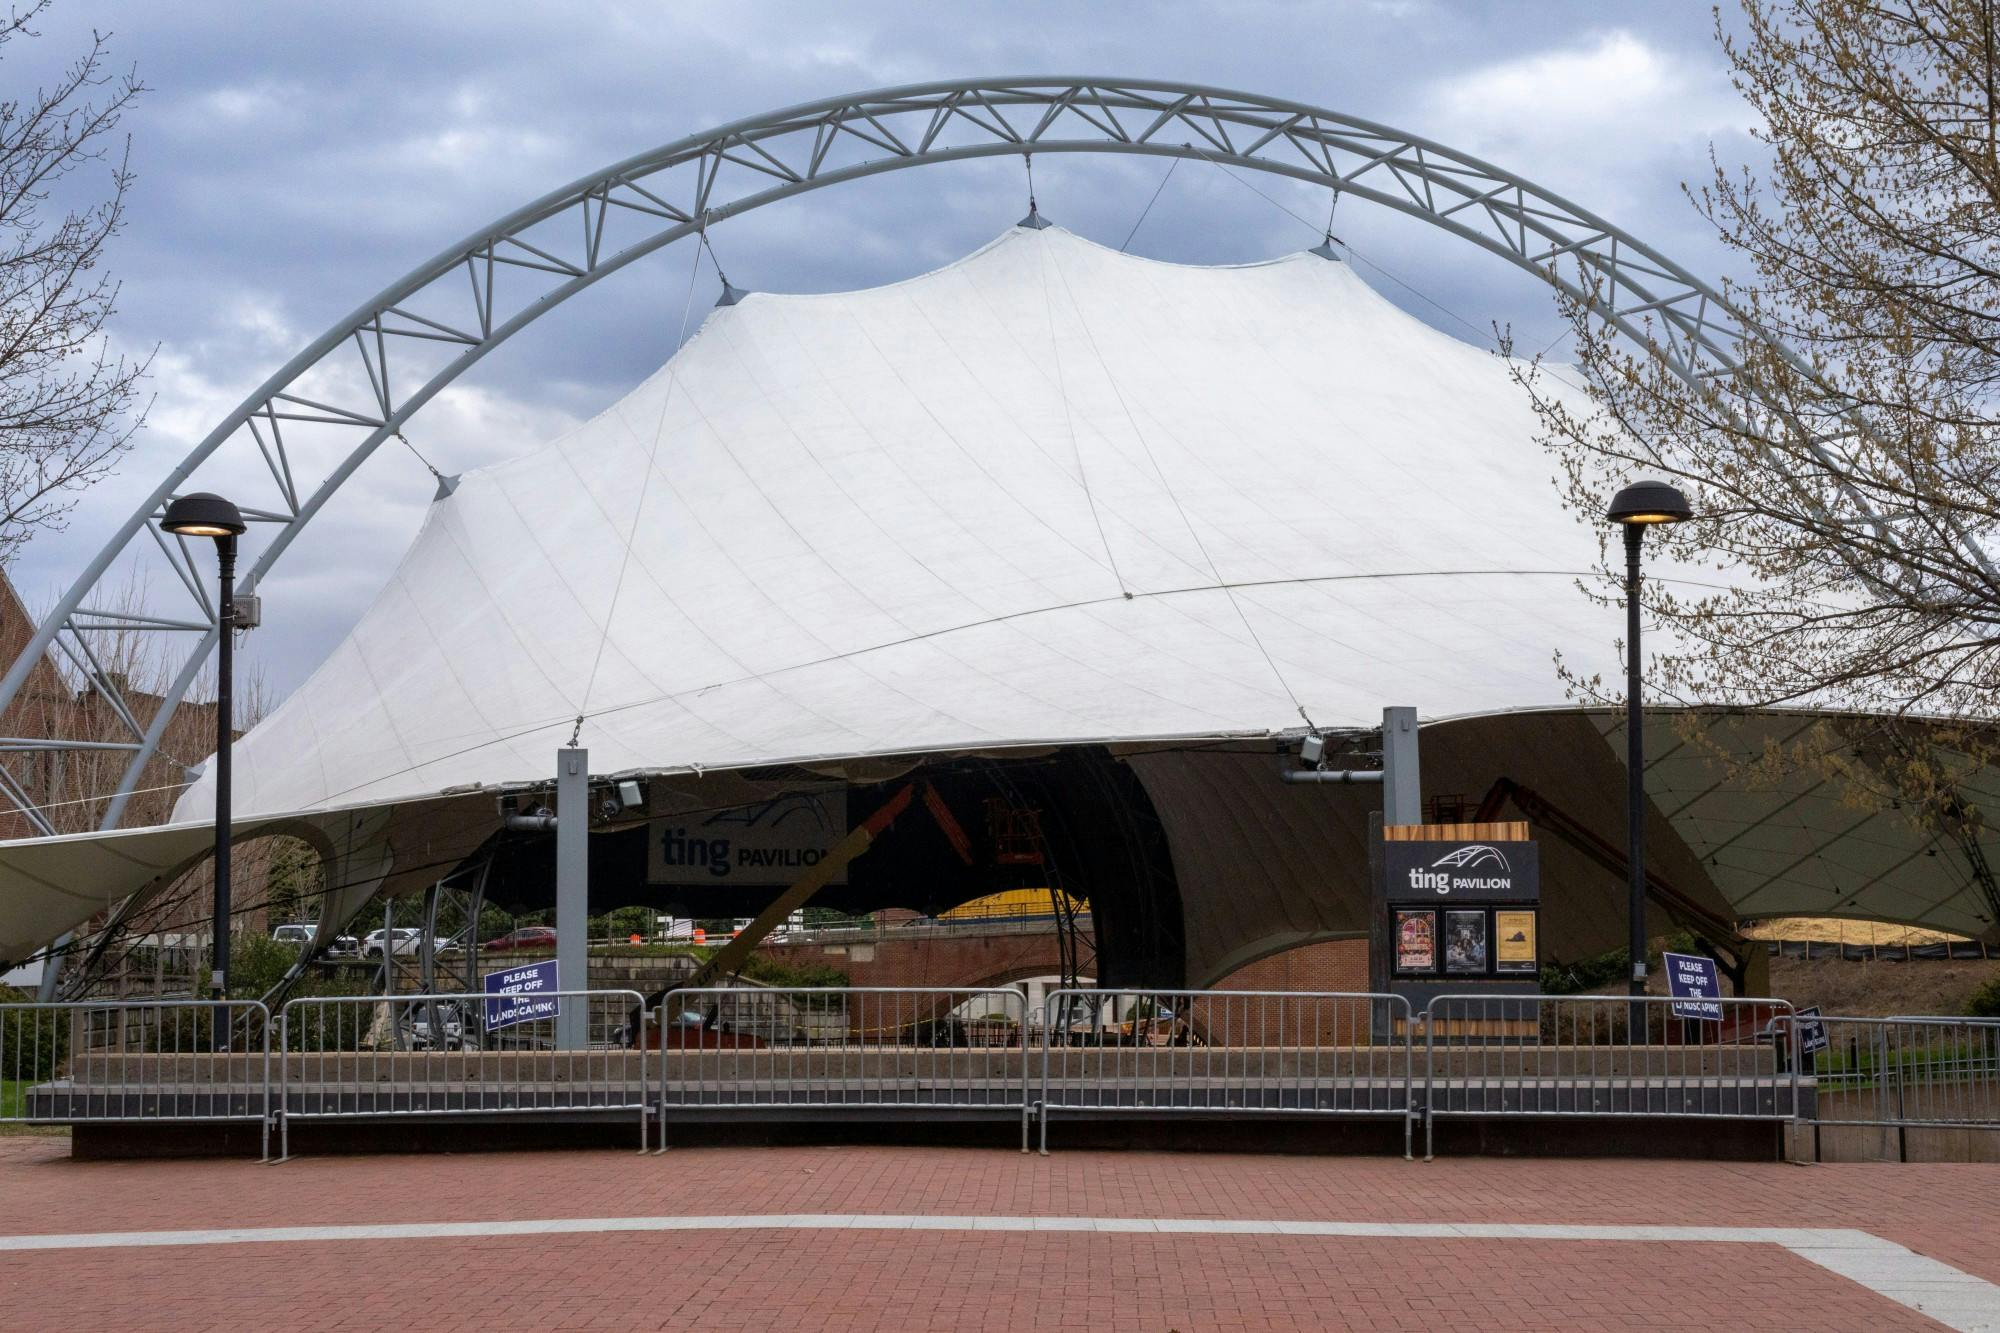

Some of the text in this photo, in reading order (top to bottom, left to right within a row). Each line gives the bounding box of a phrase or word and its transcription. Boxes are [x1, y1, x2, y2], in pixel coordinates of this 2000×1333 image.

[661, 828, 828, 877] ting PAVILIO
[1408, 867, 1511, 895] ting PAVILION
[1678, 960, 1704, 973] PLEASE
[503, 969, 539, 985] PLEASE
[1678, 973, 1709, 986] KEEP OFF
[499, 980, 543, 996] KEEP OFF
[1688, 987, 1703, 999] THE
